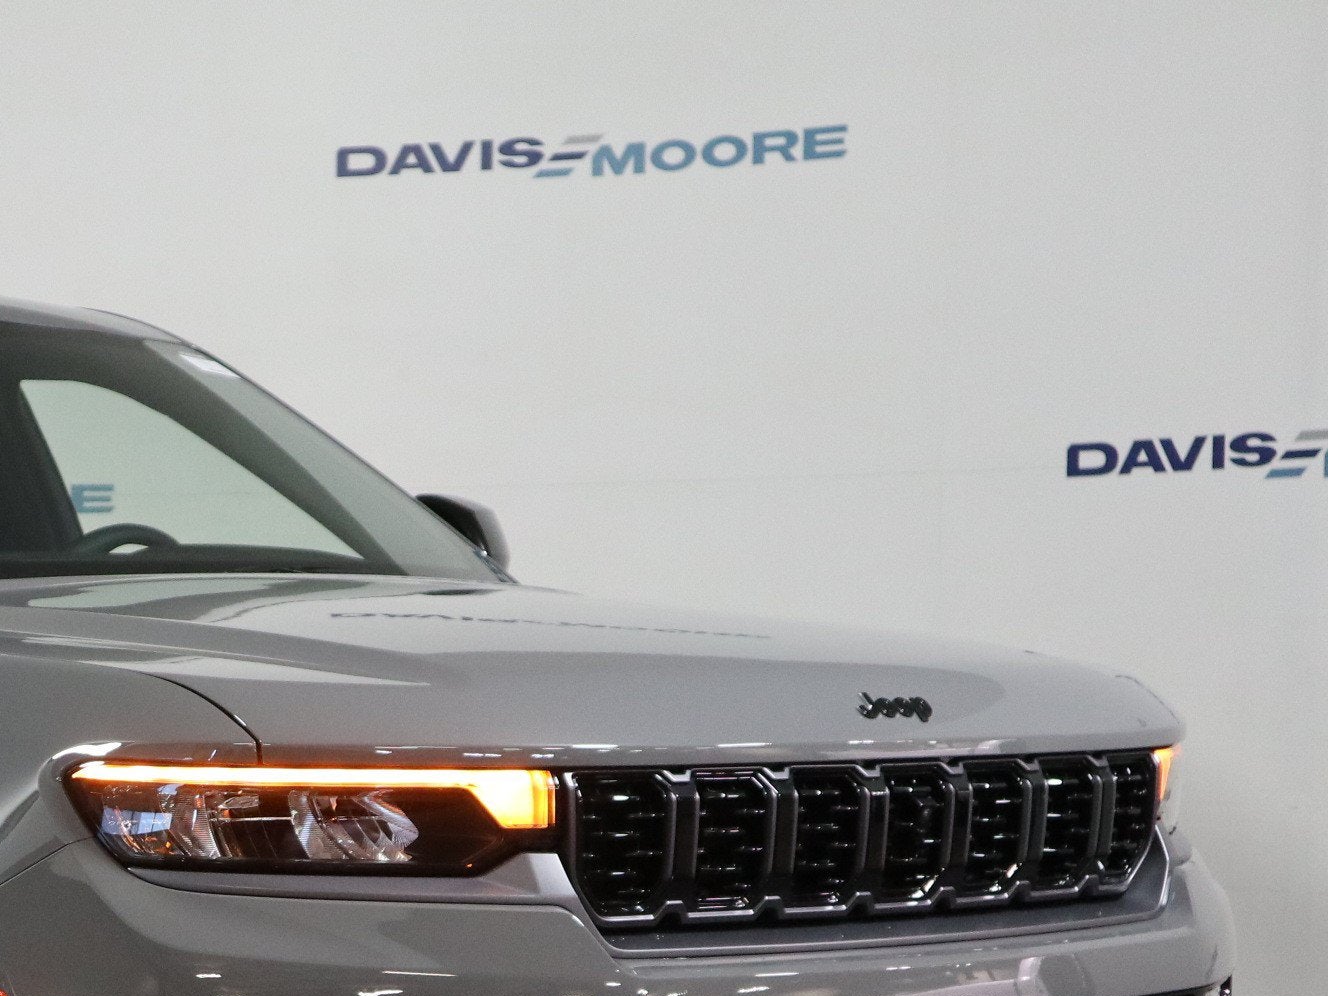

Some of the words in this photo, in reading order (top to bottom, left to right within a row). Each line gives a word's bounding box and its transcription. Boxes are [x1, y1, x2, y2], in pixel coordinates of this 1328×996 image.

[336, 137, 544, 178] DAVIS
[591, 124, 849, 178] MOORE
[1067, 432, 1277, 477] DAVIS
[856, 692, 933, 722] Jeep
